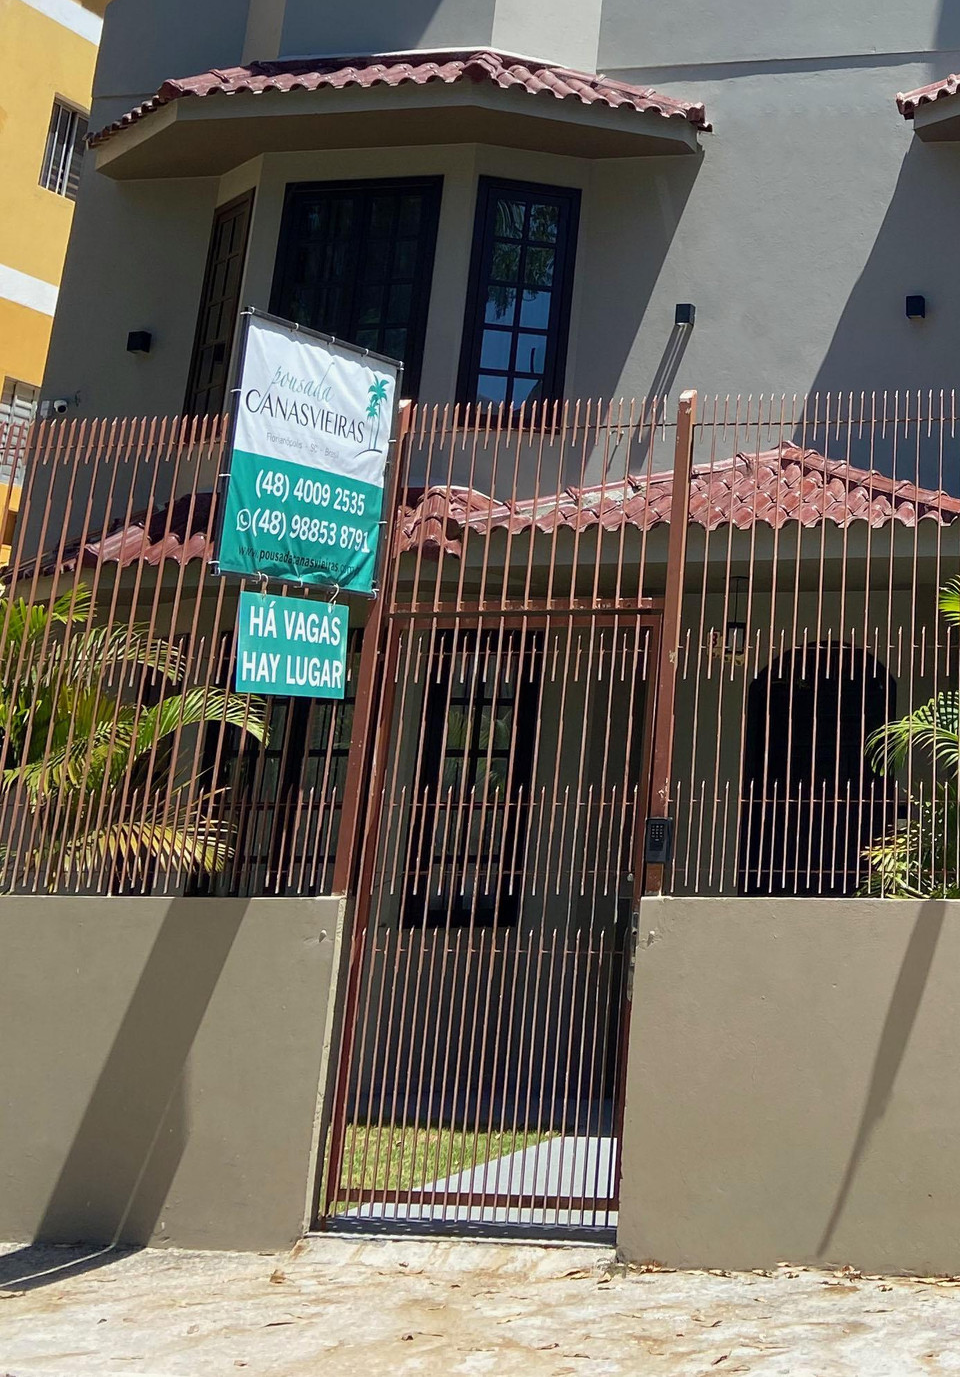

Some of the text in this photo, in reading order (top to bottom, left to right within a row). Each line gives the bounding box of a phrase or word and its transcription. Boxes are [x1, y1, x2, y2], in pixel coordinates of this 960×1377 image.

[260, 362, 335, 406] pousada
[245, 389, 365, 443] CANASVIEIRAS
[310, 443, 318, 454] SC
[255, 469, 366, 516] (48) 4009 2535
[252, 507, 370, 553] (48) 98853 8791
[249, 601, 341, 646] HÁ VAGAS
[241, 651, 343, 689] HAY LUGAR
